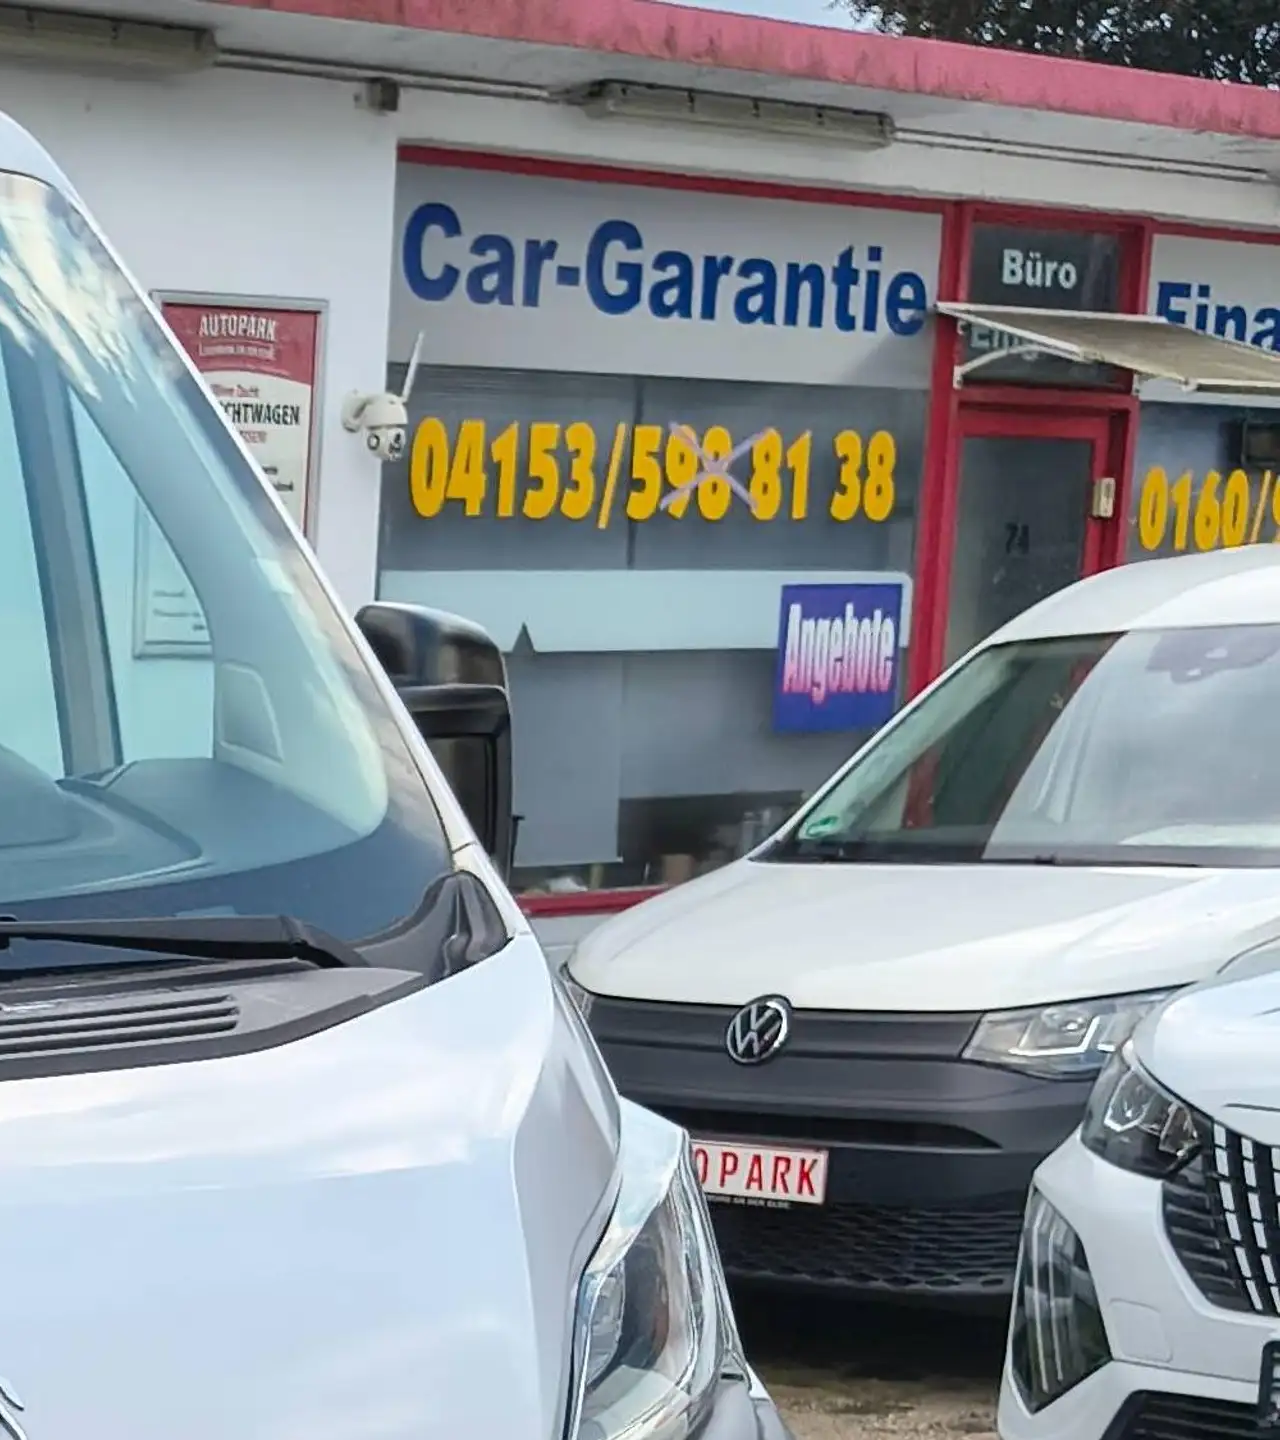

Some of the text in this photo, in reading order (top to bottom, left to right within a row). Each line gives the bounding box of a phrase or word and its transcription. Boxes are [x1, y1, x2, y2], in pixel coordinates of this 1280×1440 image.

[402, 203, 928, 336] Car-Garantie
[1002, 248, 1078, 288] Büro
[199, 314, 277, 341] AUTOPARK
[410, 416, 897, 528] 04153/598 81 38
[782, 602, 896, 705] Angebote
